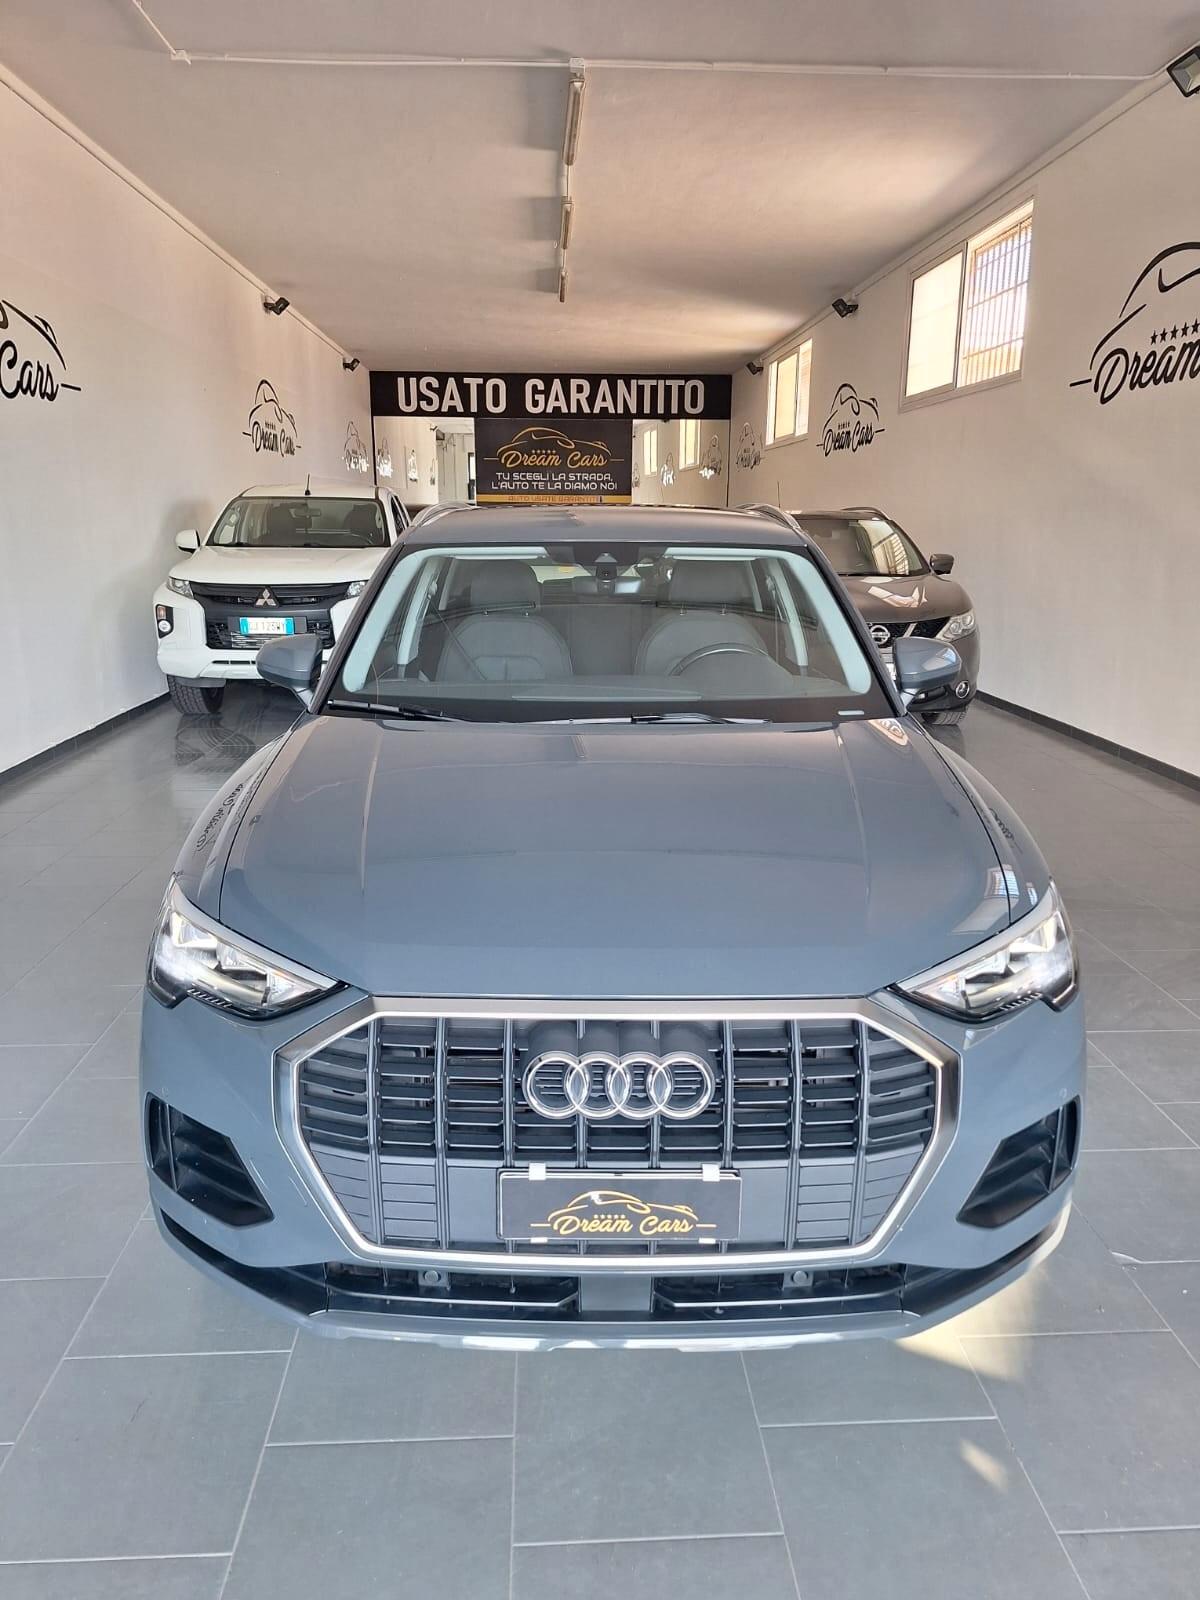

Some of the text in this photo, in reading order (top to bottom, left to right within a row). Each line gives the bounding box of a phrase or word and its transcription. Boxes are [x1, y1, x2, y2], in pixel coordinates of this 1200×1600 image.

[0, 340, 59, 402] Cars
[1094, 339, 1200, 405] Dream
[397, 376, 705, 415] USATO GARANTITO
[501, 450, 608, 469] Dream Cars
[491, 481, 618, 490] L'AUTO TE LA DIAMO NOI
[496, 472, 613, 482] TU SCEGLI LA STRADA,
[553, 1215, 694, 1235] Dream Cars
